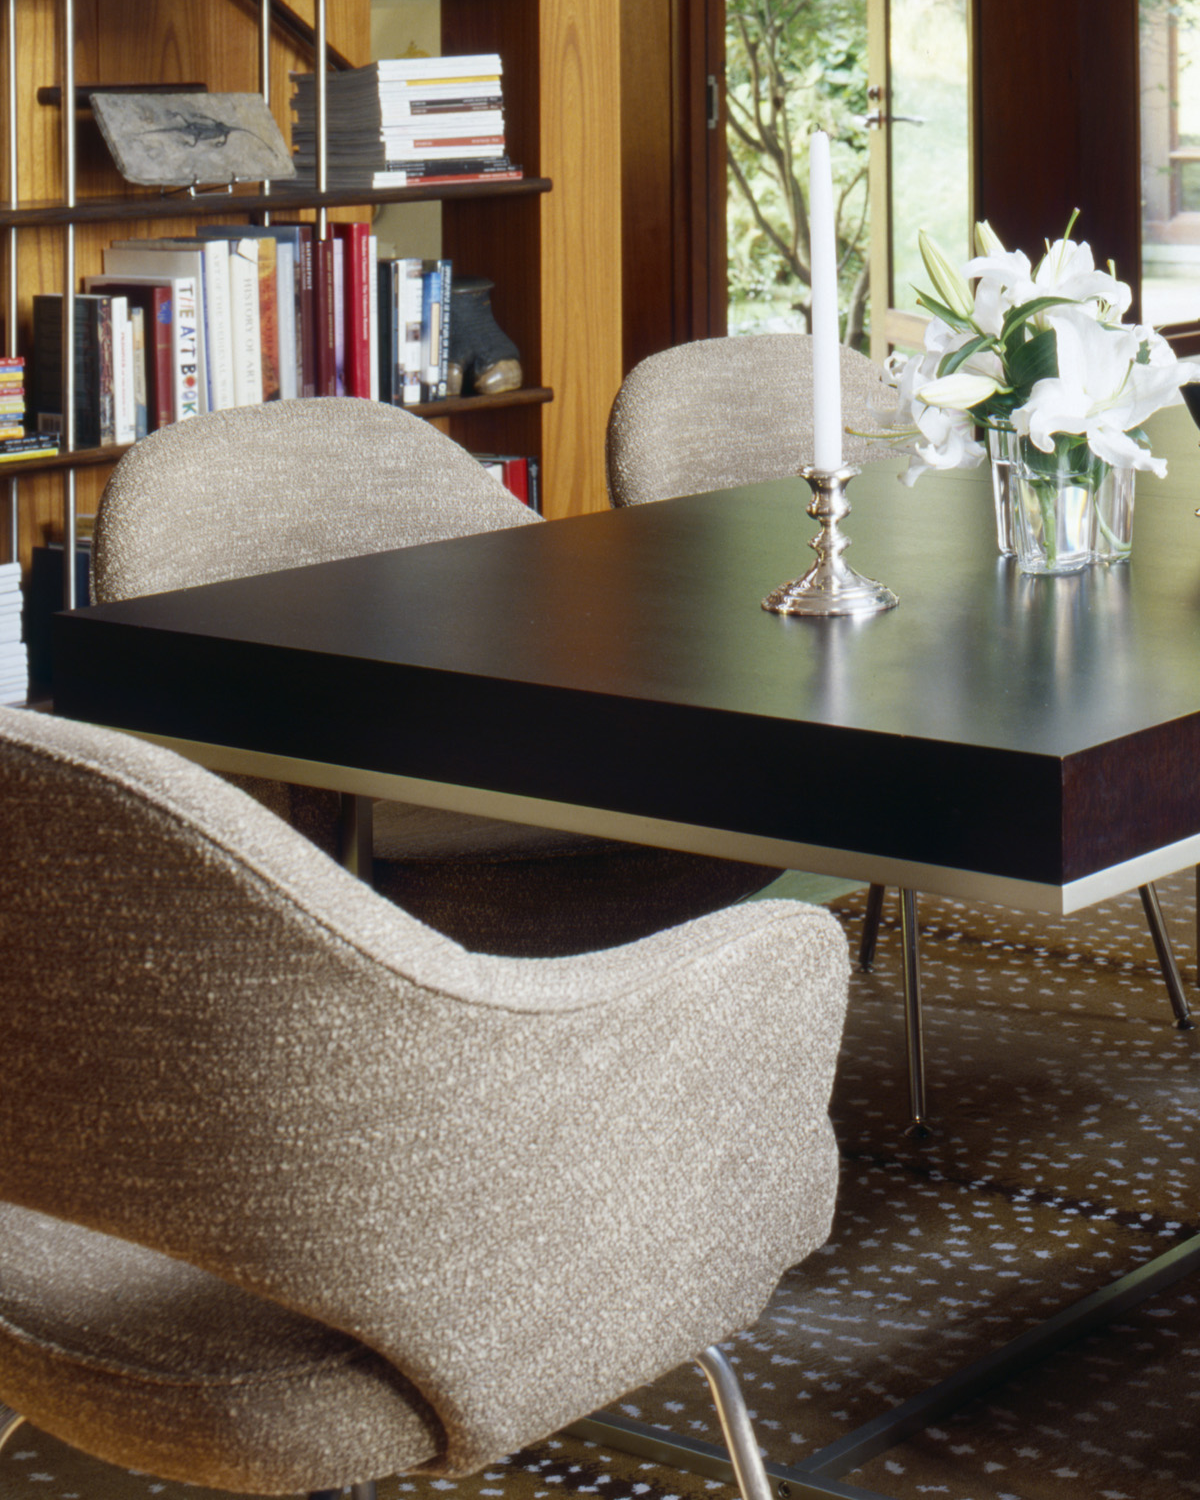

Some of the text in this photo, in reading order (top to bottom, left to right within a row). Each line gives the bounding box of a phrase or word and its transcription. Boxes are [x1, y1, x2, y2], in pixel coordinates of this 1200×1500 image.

[243, 279, 256, 385] HISTORY OF ART
